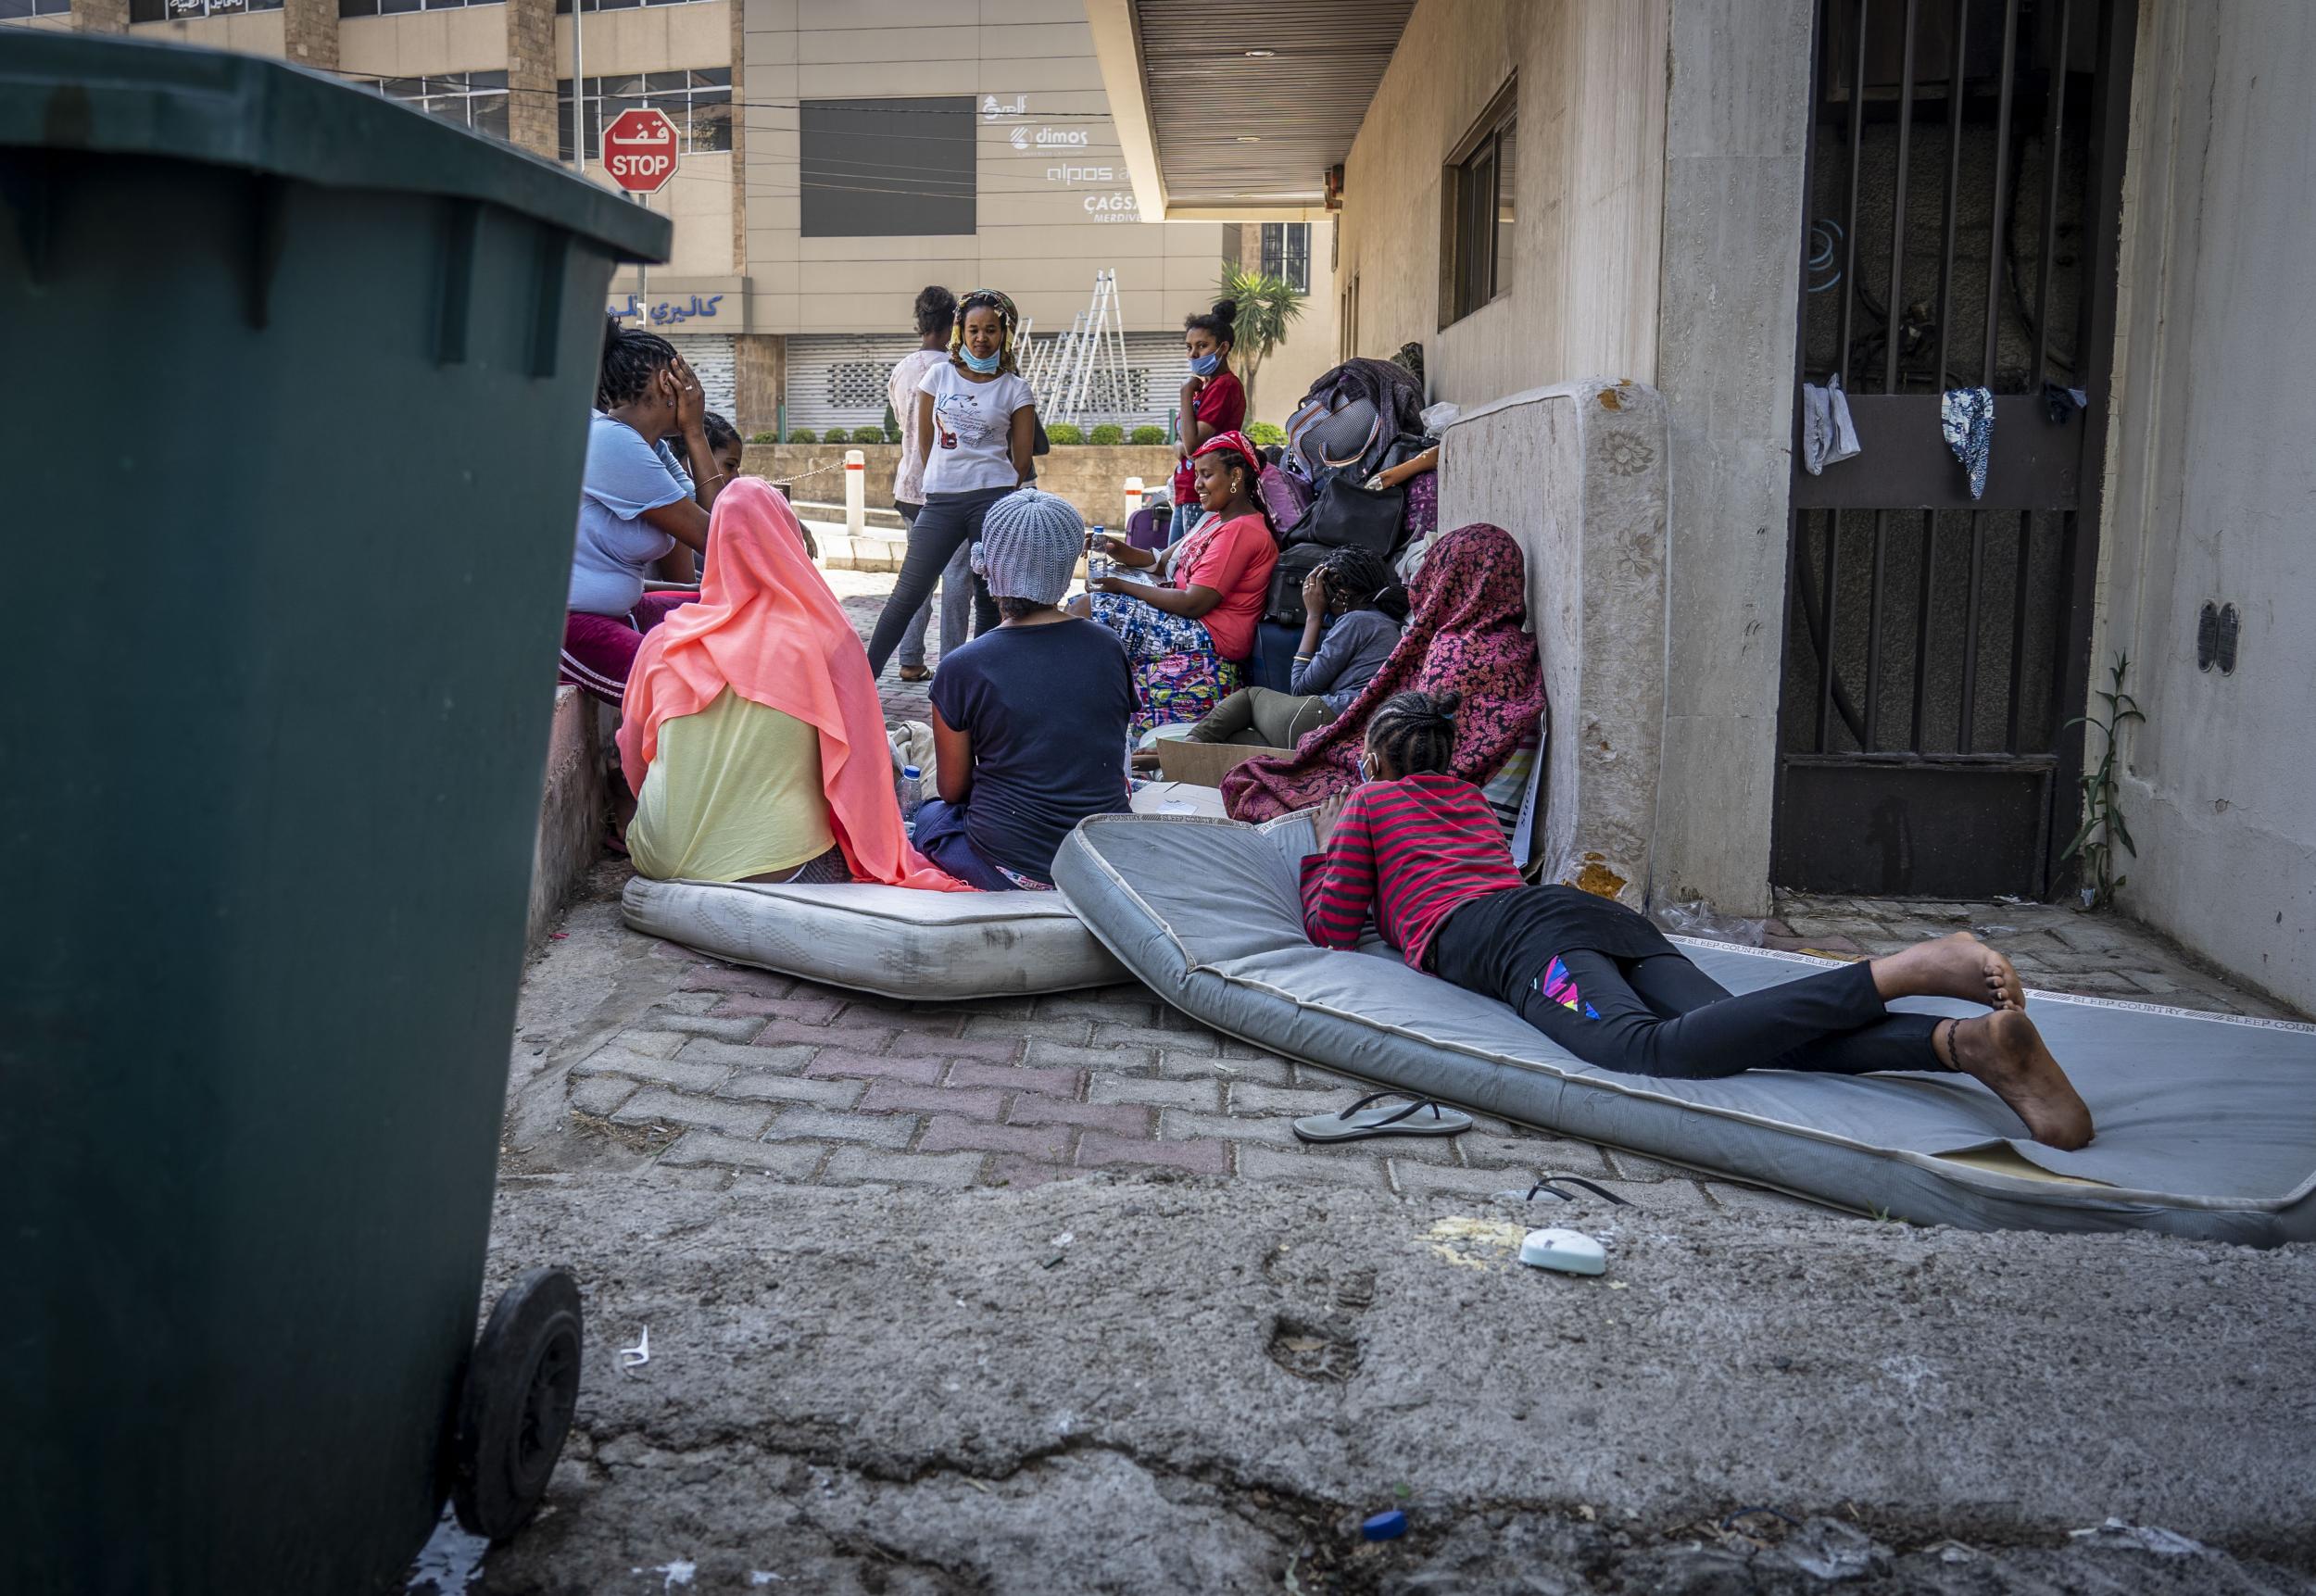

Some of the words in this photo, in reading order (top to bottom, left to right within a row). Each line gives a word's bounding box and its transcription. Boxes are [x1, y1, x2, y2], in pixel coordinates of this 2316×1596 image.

[612, 120, 670, 145] قف
[1036, 127, 1088, 145] dimos
[612, 155, 669, 176] STOP
[1094, 213, 1141, 223] MERDİVE
[649, 295, 724, 325] كاليري
[1163, 814, 1184, 823] SLEEP
[1687, 937, 1719, 949] SLEEP
[1721, 943, 1772, 957] COUNTRY
[1804, 956, 1840, 968] SLEEP
[2072, 996, 2116, 1008] SLEEP
[2118, 1000, 2182, 1016] COUNTRY
[2226, 1015, 2270, 1028] SLEEP
[2274, 1021, 2316, 1033] COUN
